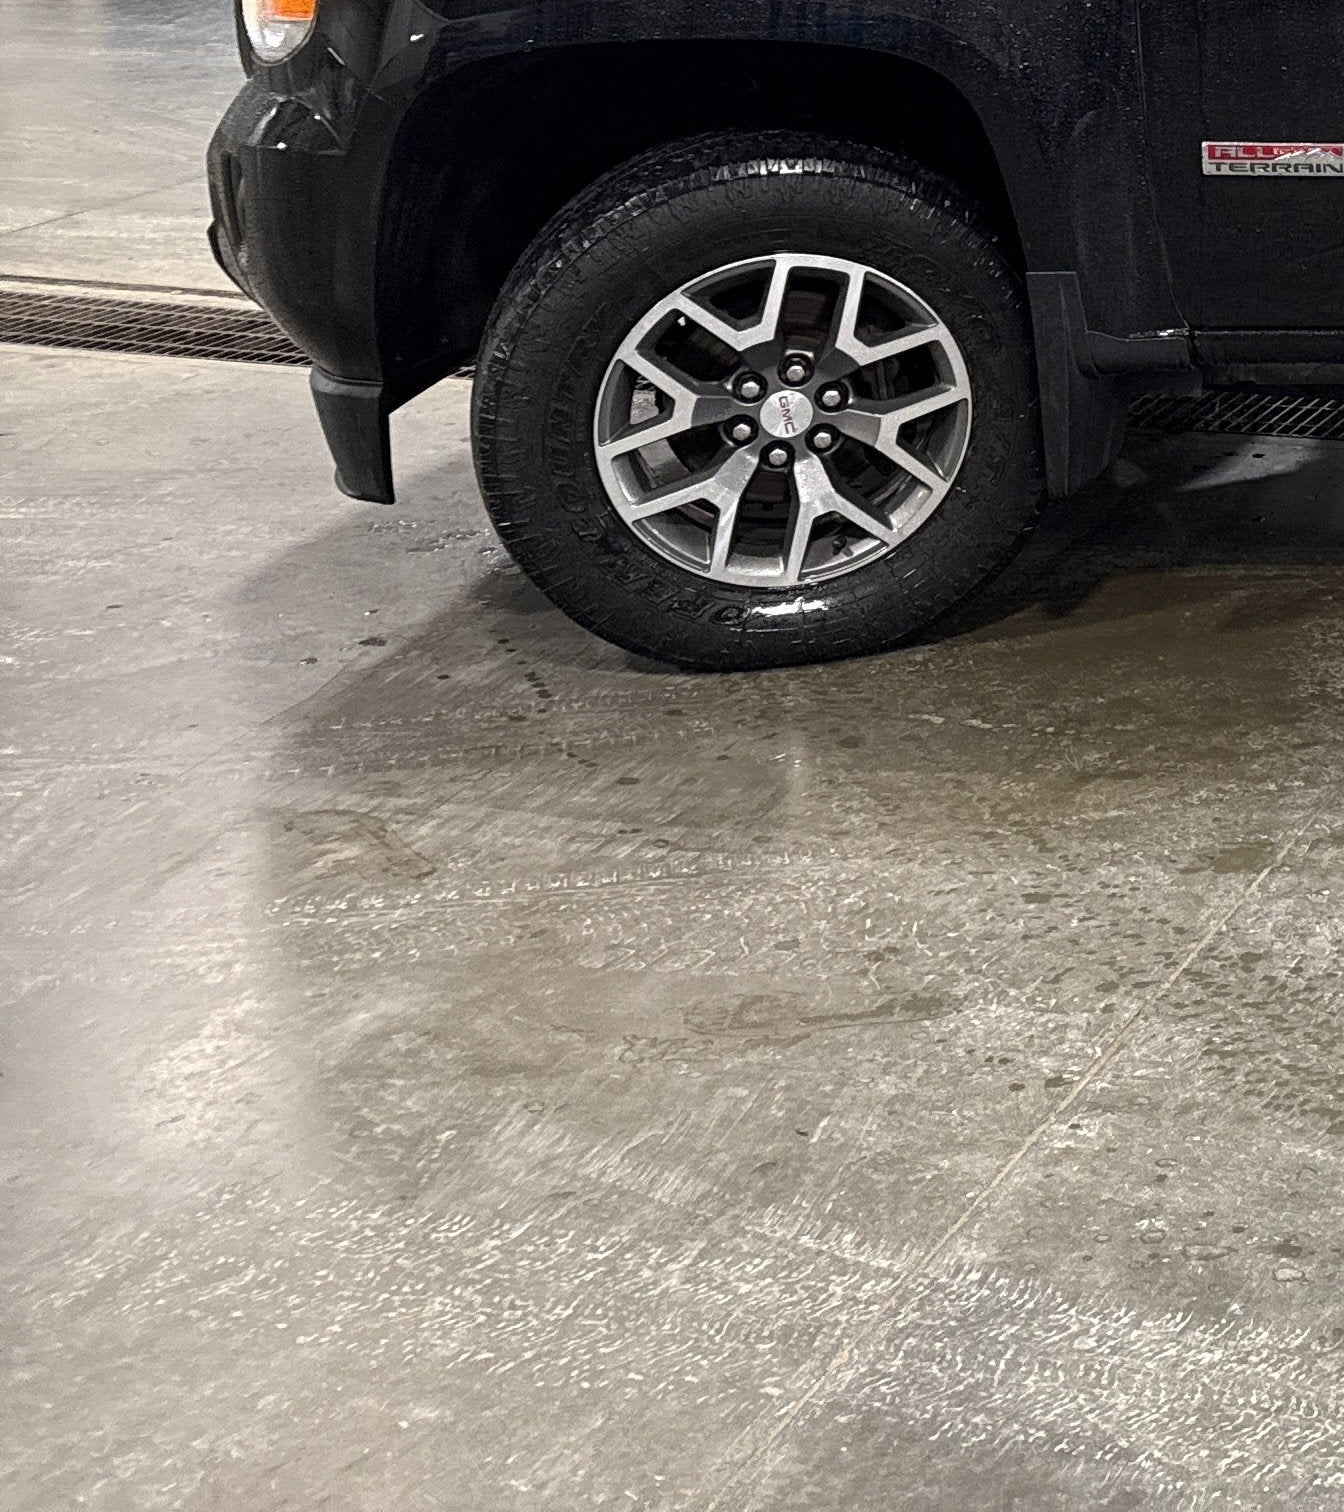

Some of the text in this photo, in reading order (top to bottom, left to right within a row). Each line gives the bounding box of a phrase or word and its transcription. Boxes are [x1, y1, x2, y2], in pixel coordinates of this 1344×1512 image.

[1214, 144, 1276, 160] ALL
[1207, 162, 1344, 174] TERRAIN
[778, 395, 799, 435] GMC
